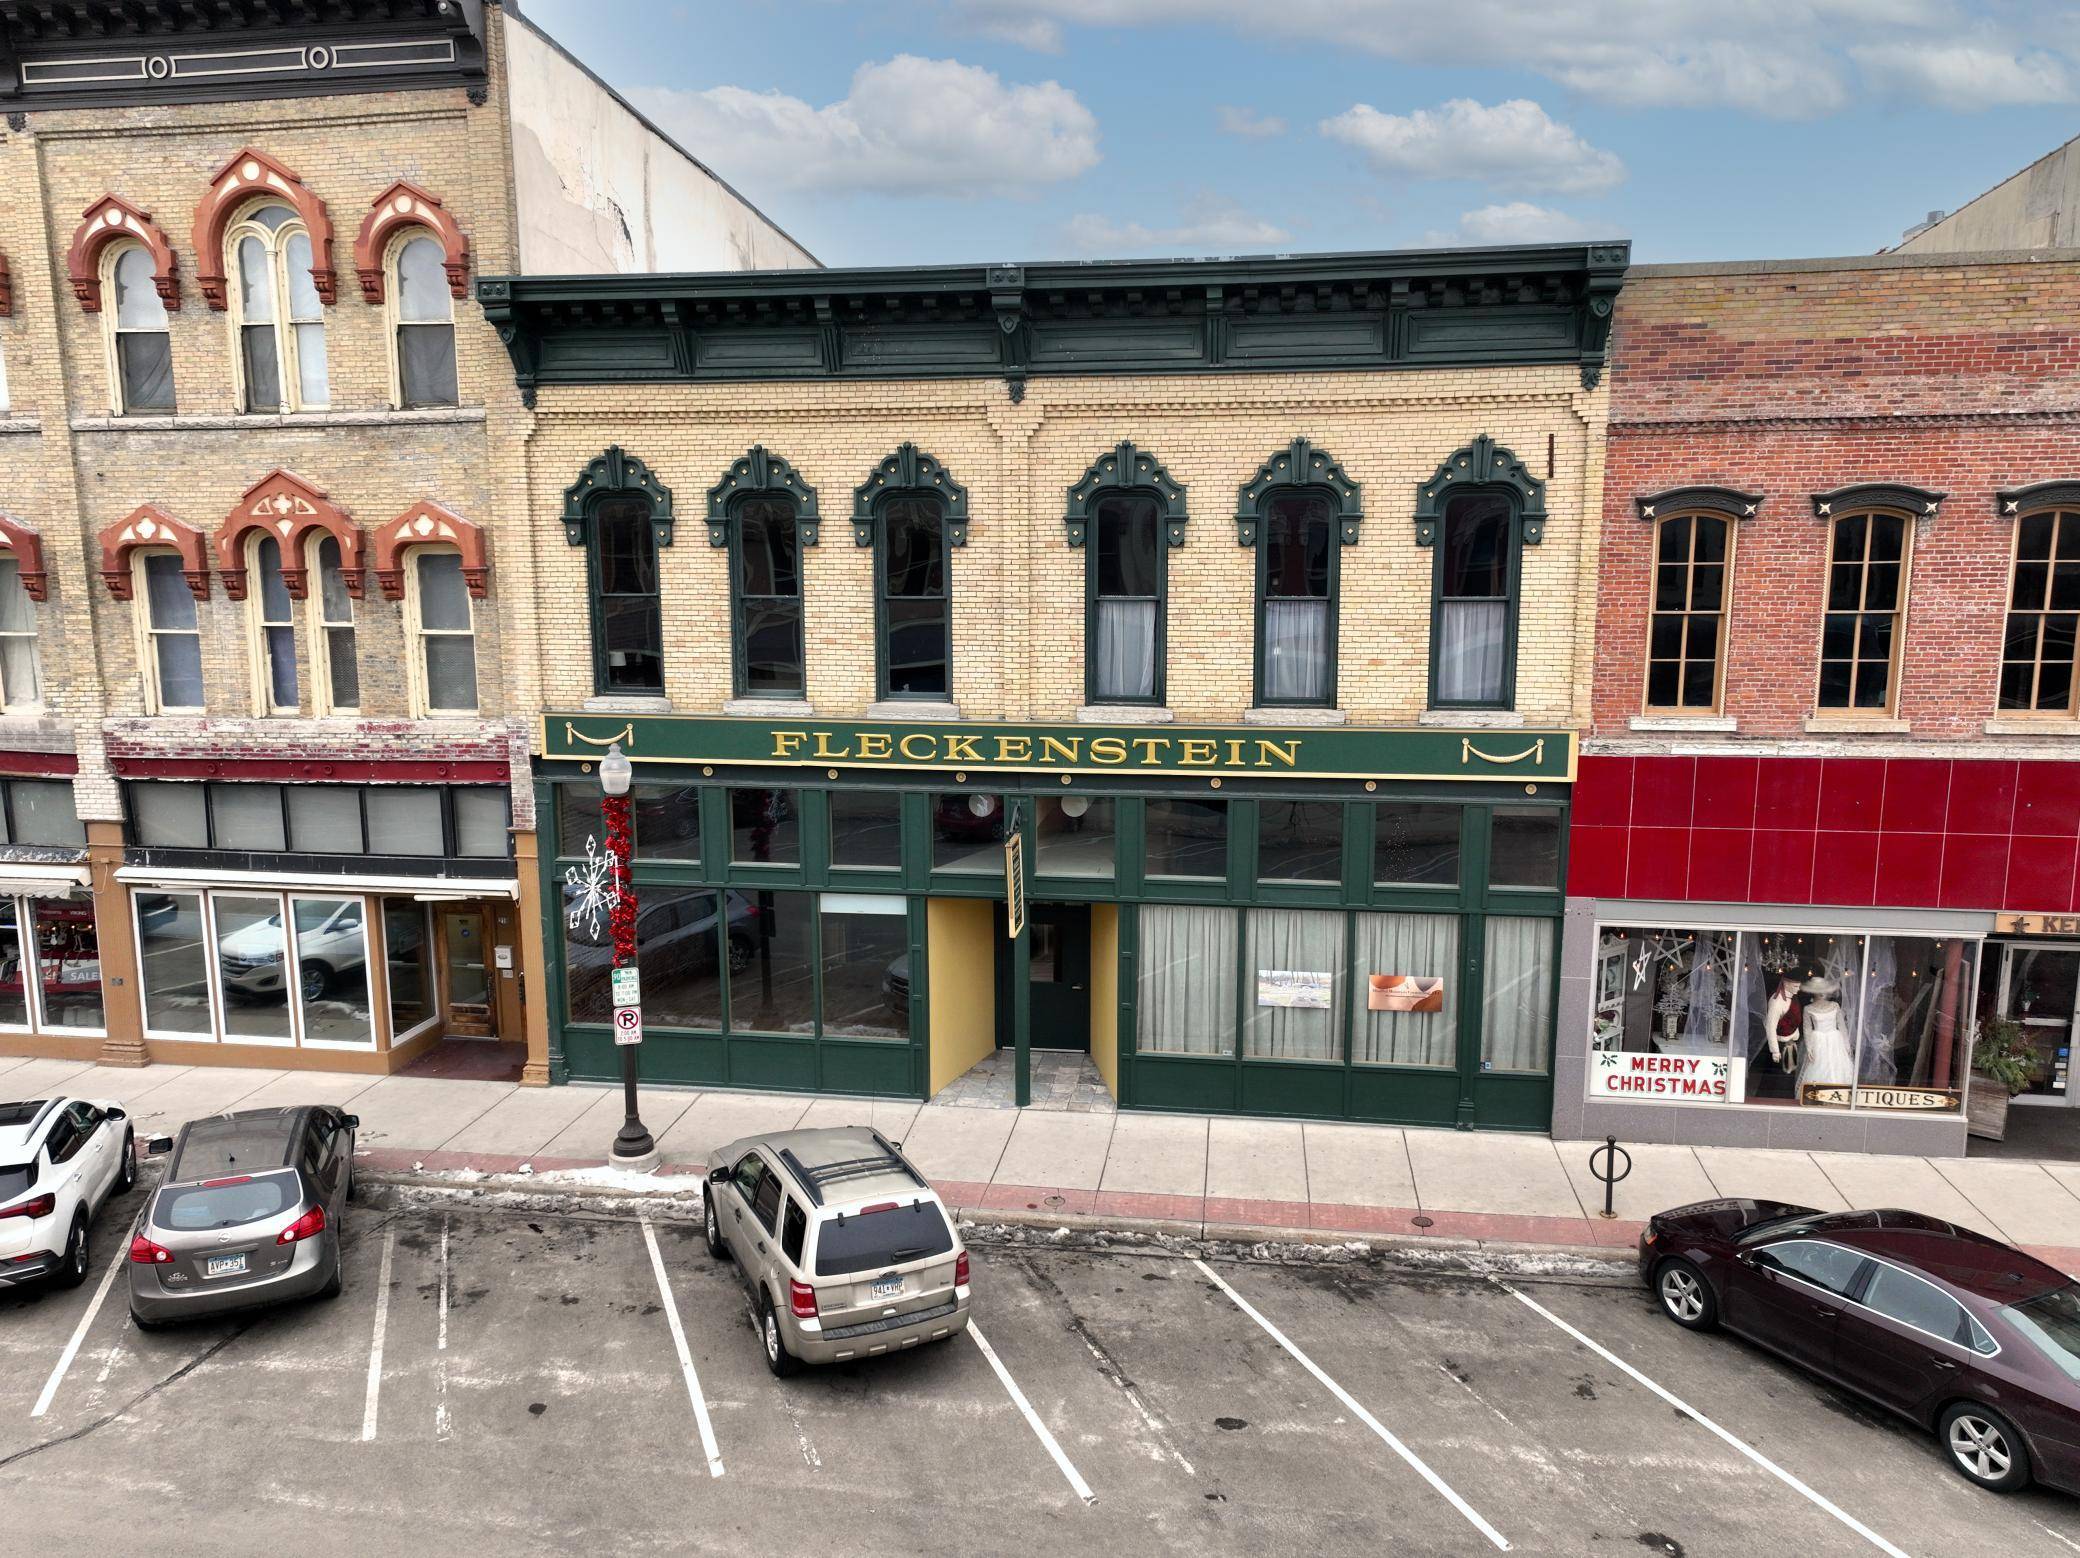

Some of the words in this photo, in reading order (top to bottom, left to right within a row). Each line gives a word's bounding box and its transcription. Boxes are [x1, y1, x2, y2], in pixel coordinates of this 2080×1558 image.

[770, 731, 1302, 767] FLECKENSTEIN
[1631, 1056, 1701, 1073] MERRY
[1607, 1075, 1726, 1095] CHRISTMAS
[1829, 1090, 1935, 1106] ATIQUES
